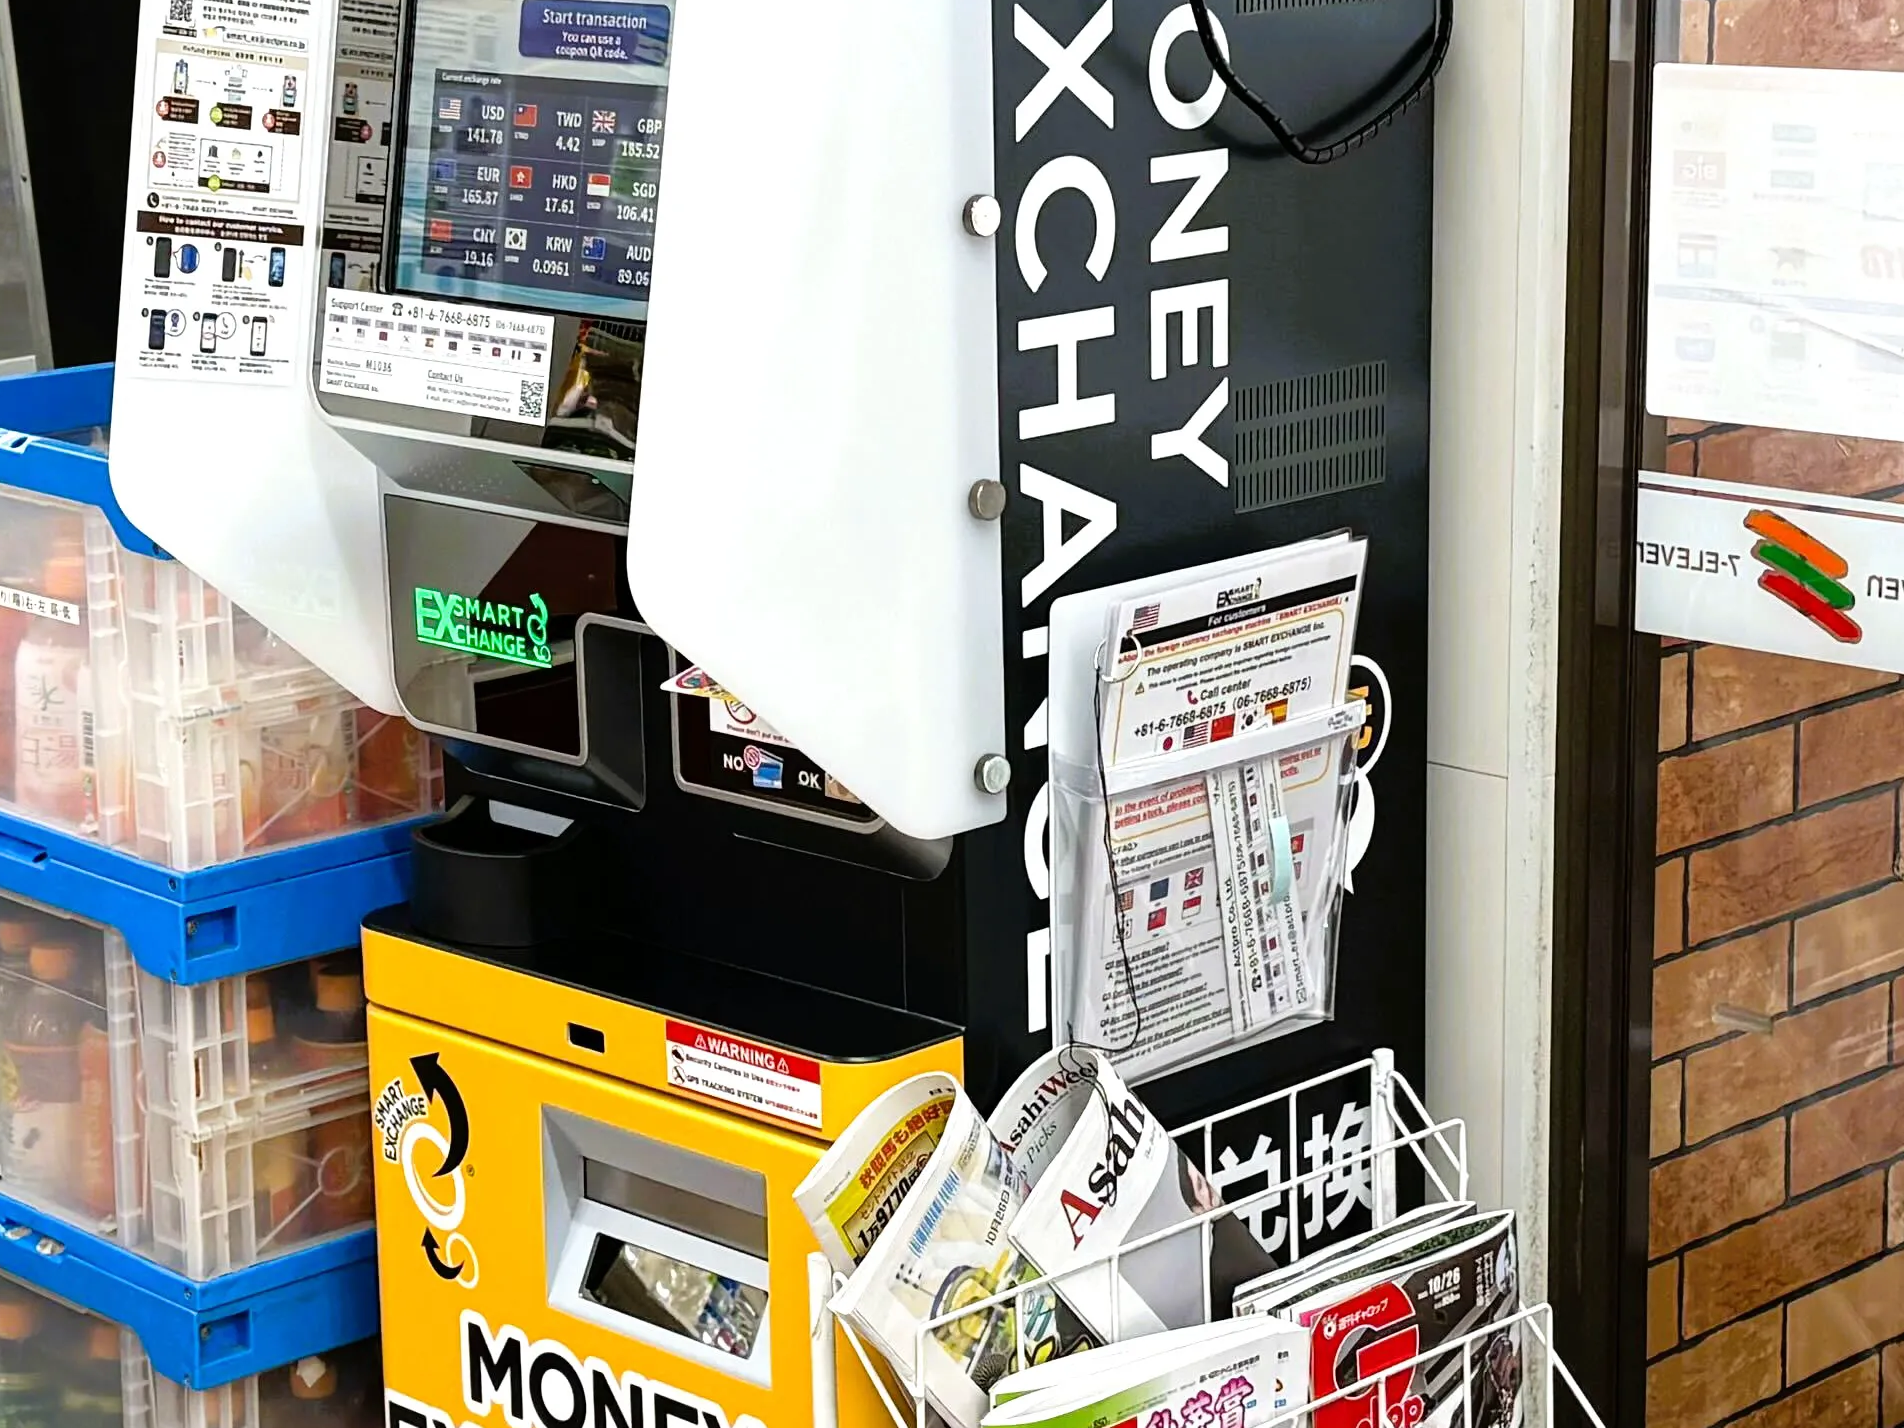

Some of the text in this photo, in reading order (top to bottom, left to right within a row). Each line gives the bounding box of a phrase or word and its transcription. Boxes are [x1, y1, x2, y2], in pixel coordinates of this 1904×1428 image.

[542, 9, 647, 29] Start transaction
[563, 32, 578, 43] You
[556, 45, 587, 59] coupon
[605, 47, 628, 59] code.
[482, 105, 505, 122] USD
[556, 111, 582, 129] TWD
[637, 118, 662, 135] GBP
[467, 128, 503, 146] 141.78
[556, 137, 580, 153] 4.42
[621, 141, 660, 160] 185.52
[477, 166, 500, 184] EUR
[552, 173, 577, 191] HKD
[462, 189, 498, 205] 165.87
[632, 182, 656, 199] SGD
[545, 197, 574, 215] 17.61
[616, 204, 654, 224] 106.41
[546, 236, 572, 253] KRW
[626, 245, 651, 263] AUD
[533, 258, 569, 277] 0.0961
[331, 299, 358, 312] Support
[361, 302, 383, 313] Center
[454, 595, 524, 631] SMART
[1208, 605, 1266, 627] For customers
[1148, 665, 1161, 677] The
[1163, 656, 1198, 673] operating
[1200, 647, 1233, 665] company
[1235, 646, 1241, 654] is
[1243, 637, 1269, 651] SMART
[1271, 625, 1311, 643] EXCHANGE
[1200, 679, 1251, 700] Call center
[723, 754, 744, 772] NO
[798, 770, 820, 789] OK
[686, 1054, 711, 1068] Security
[707, 1036, 776, 1069] WARNING
[687, 1075, 763, 1104] GPS TRACKING SYSTEM
[1060, 1097, 1145, 1251] Asah
[1428, 1266, 1461, 1297] 10/26
